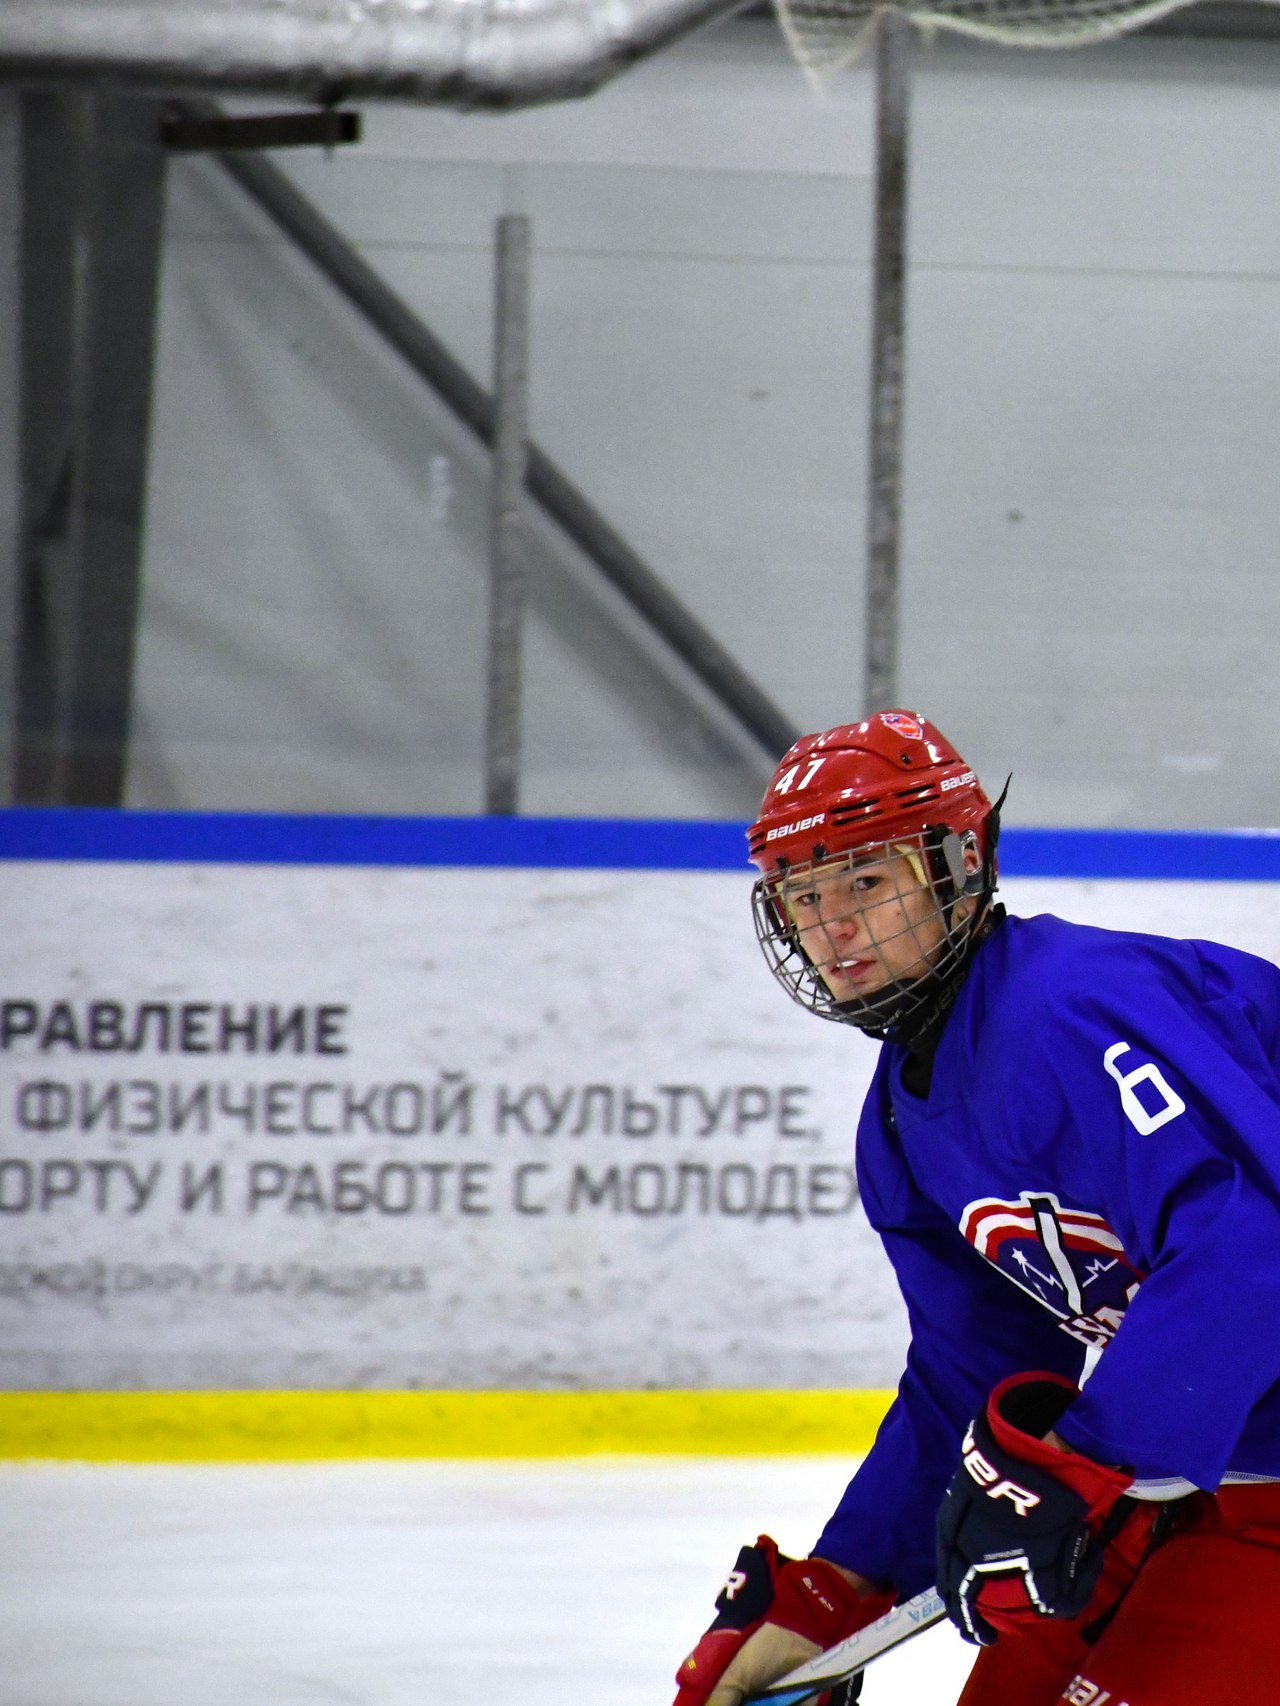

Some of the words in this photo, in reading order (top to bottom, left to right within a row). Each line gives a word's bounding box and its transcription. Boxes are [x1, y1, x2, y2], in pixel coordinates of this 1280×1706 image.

[774, 757, 827, 796] 47
[0, 1000, 350, 1055] РАВЛЕНИЕ
[16, 1070, 475, 1136] ФИЗИЧЕСКОЙ
[495, 1083, 822, 1142] КУЛЬТУРЕ,
[1103, 1041, 1186, 1136] 6
[0, 1159, 162, 1215] ОРТУ
[179, 1161, 223, 1215] И
[248, 1160, 492, 1216] РАБОТЕ
[513, 1162, 548, 1216] С
